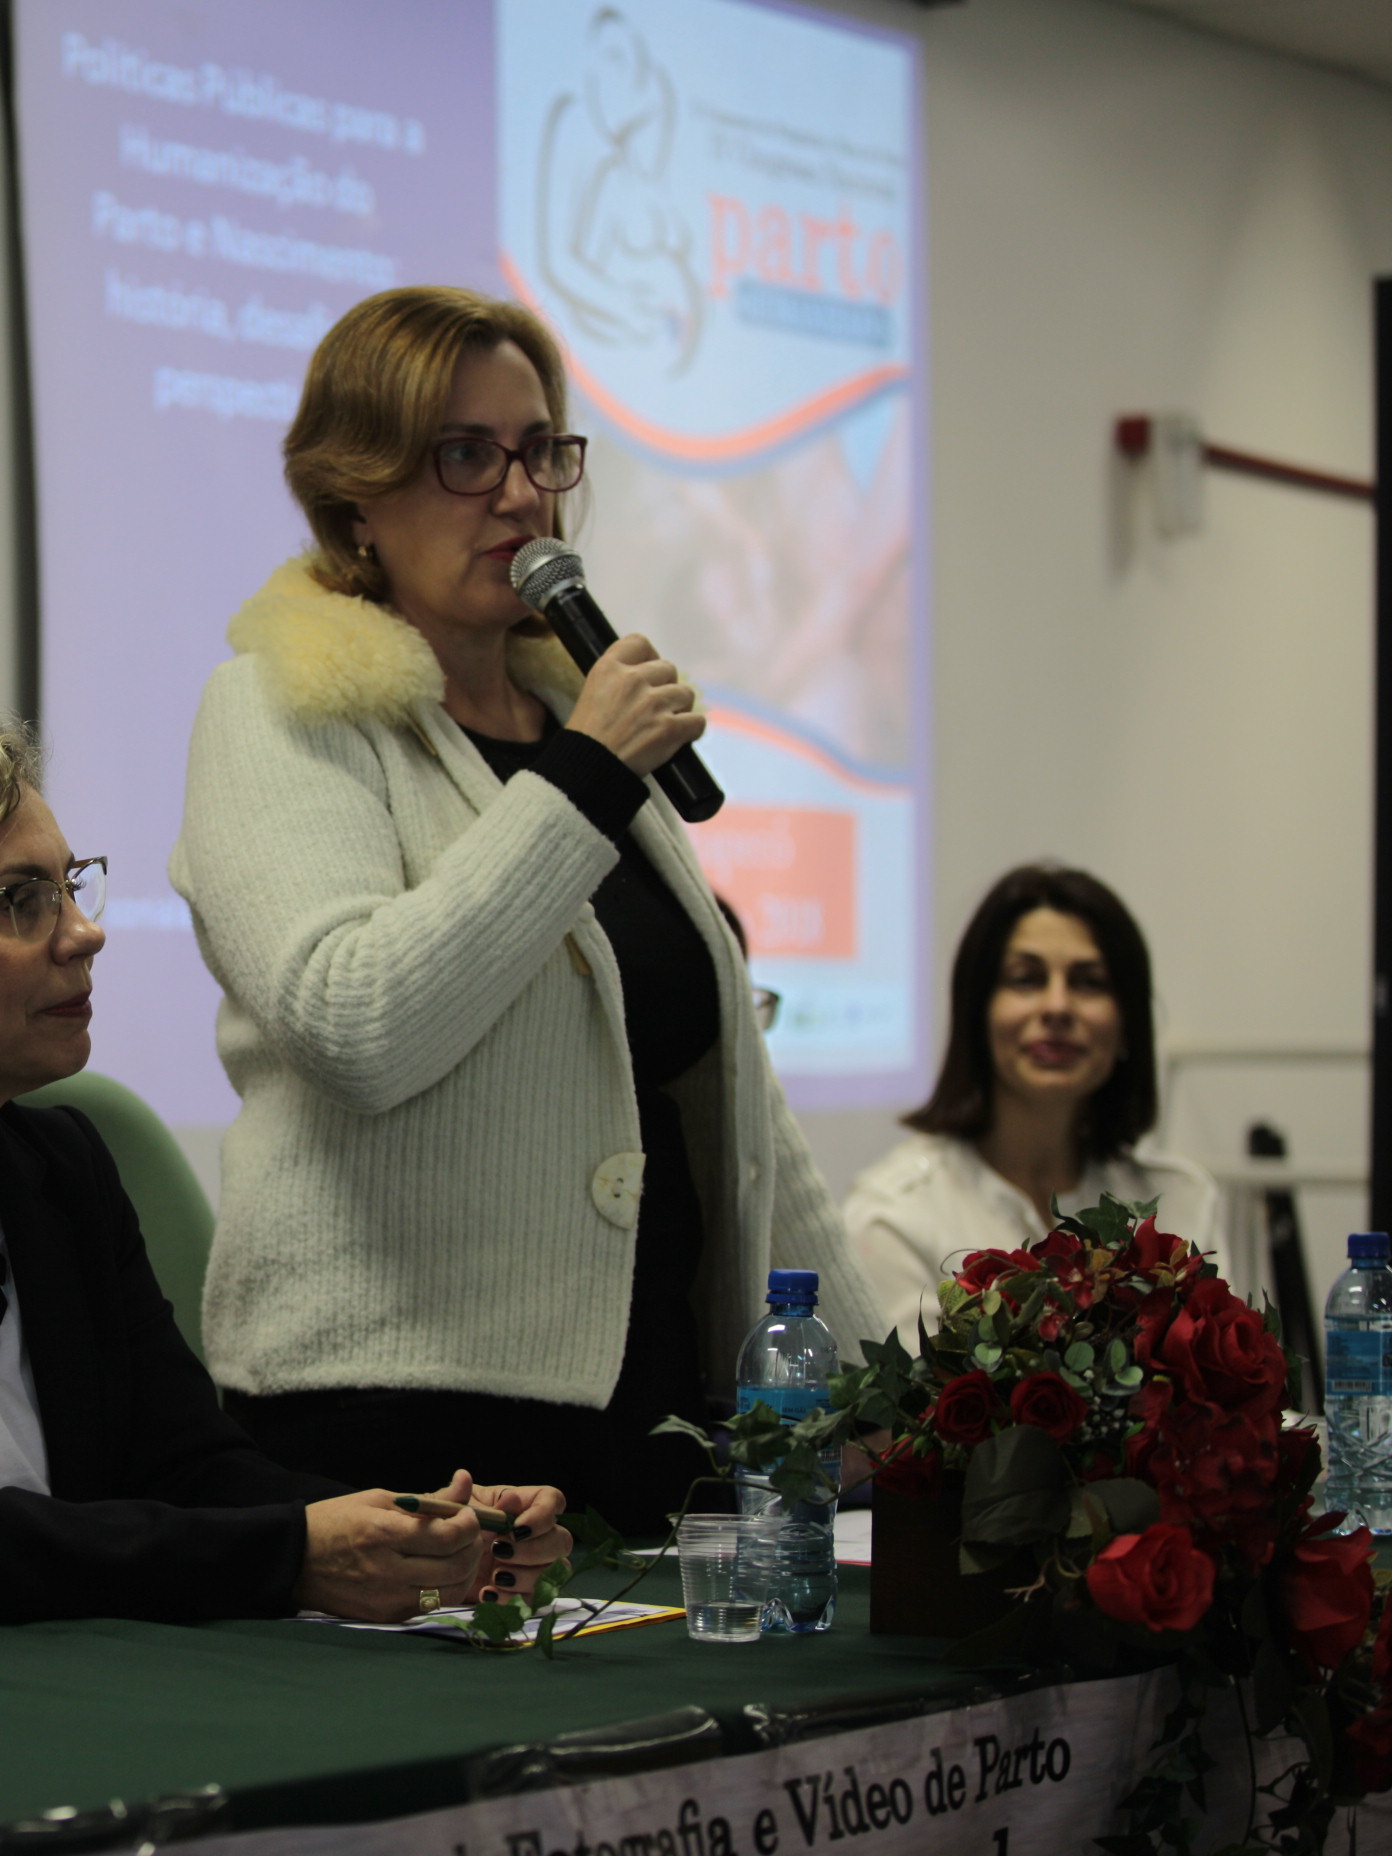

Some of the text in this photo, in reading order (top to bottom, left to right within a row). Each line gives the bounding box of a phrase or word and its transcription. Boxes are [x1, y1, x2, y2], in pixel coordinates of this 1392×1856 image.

[704, 190, 903, 306] parto
[754, 1807, 780, 1856] e
[783, 1765, 914, 1847] Vídeo
[925, 1747, 967, 1817] de
[974, 1727, 1072, 1804] Parto
